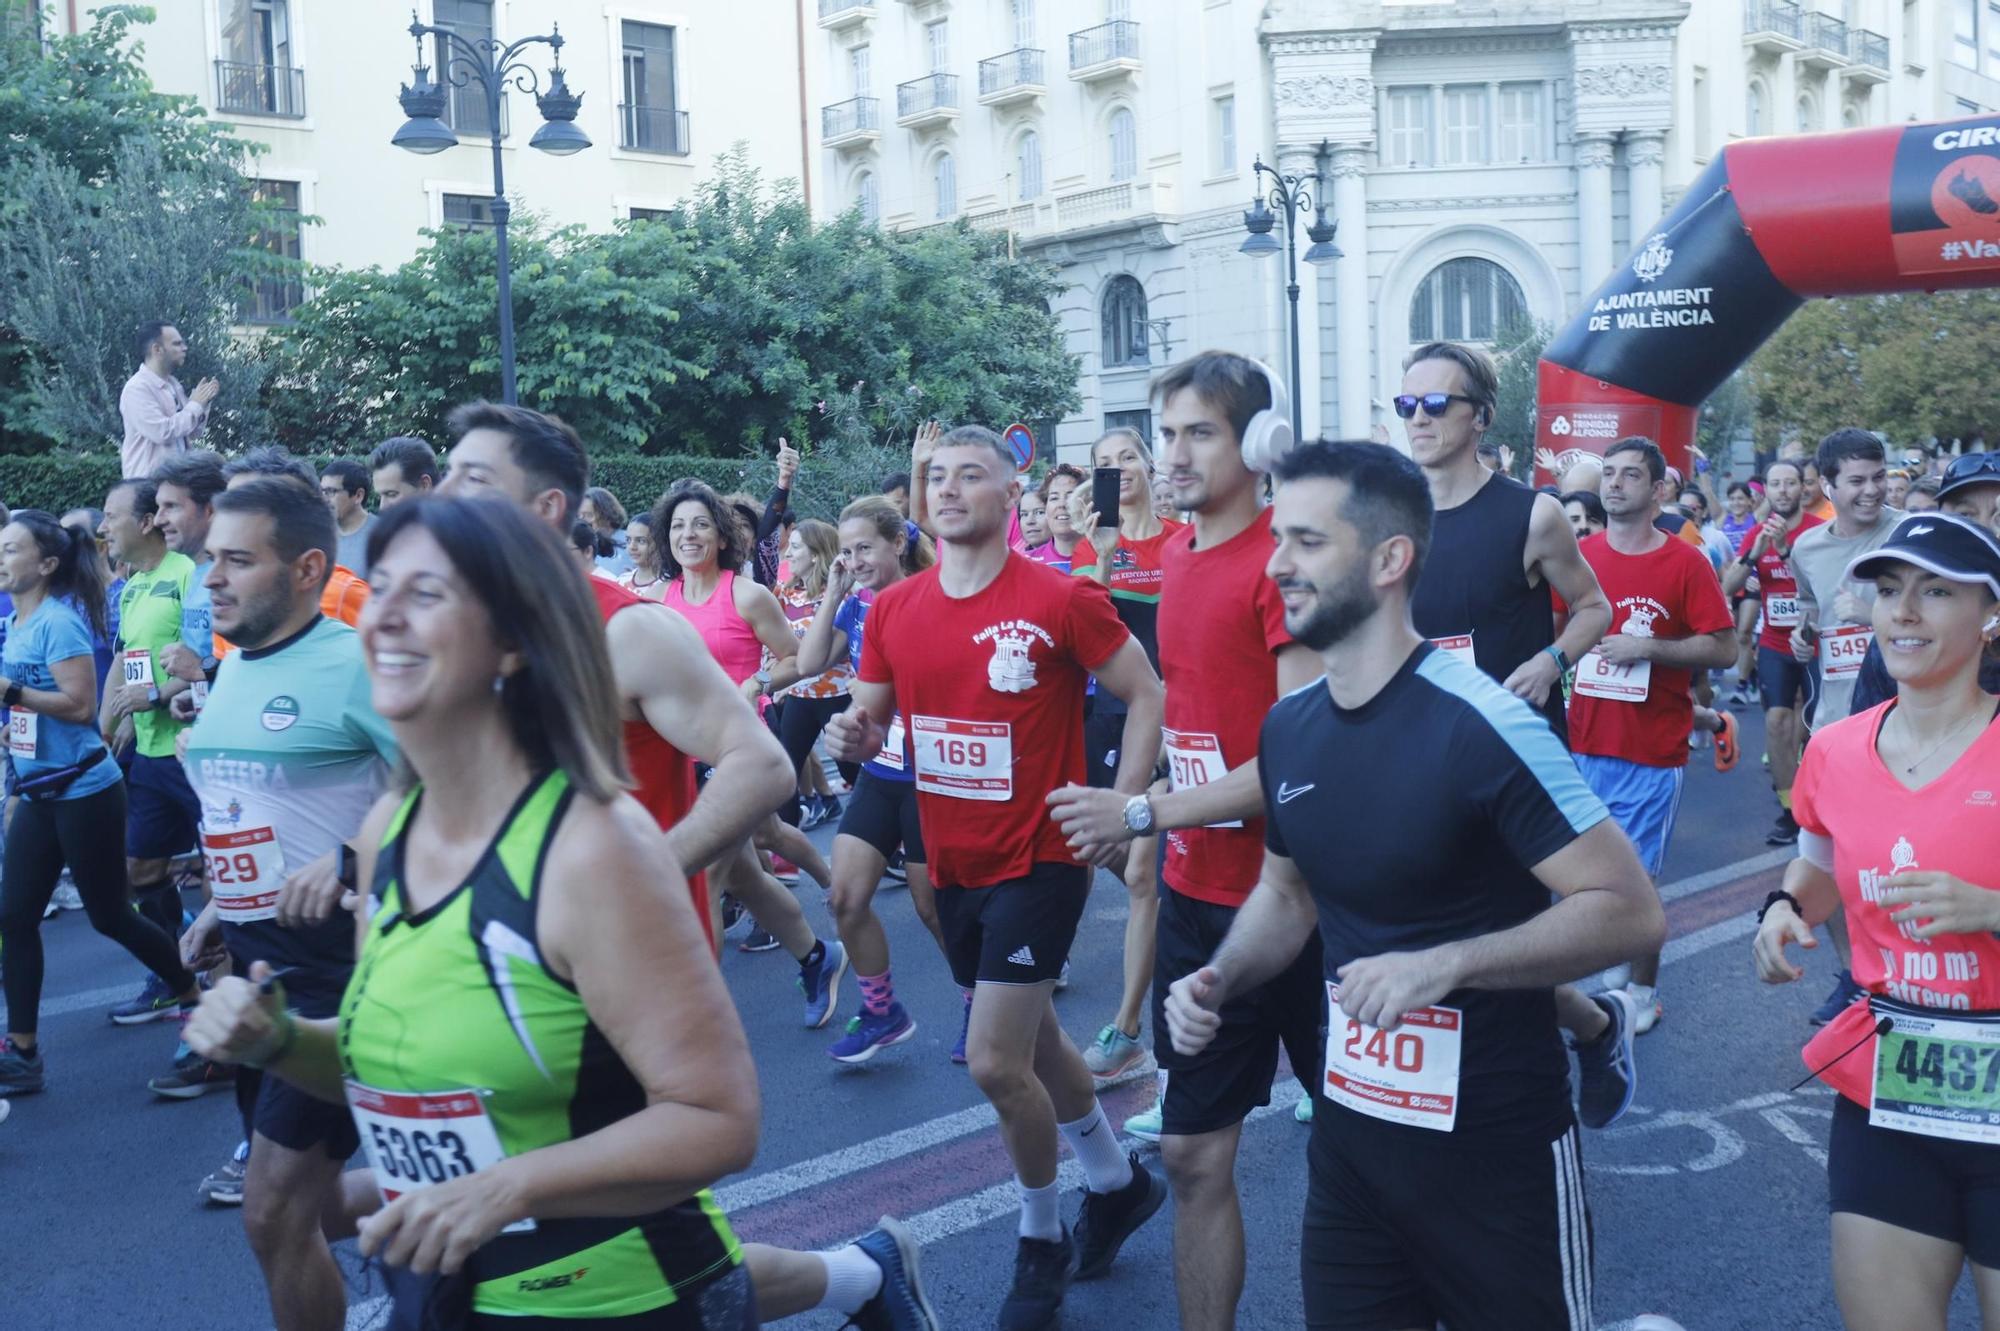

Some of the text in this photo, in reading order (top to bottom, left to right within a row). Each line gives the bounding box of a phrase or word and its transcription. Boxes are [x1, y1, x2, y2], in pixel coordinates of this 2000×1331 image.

[1593, 287, 1713, 313] AJUNTAMENT
[1588, 308, 1715, 331] DE VALÈNCIA
[1571, 429, 1618, 438] ALFONSO
[1572, 420, 1619, 429] TRINIDAD
[972, 619, 1055, 648] Falla La Barraca
[1829, 638, 1869, 657] 549
[934, 739, 986, 767] 169
[1904, 951, 1937, 980] no
[1944, 951, 1979, 981] me
[1345, 1019, 1424, 1074] 240
[1895, 1039, 2000, 1094] 4437
[369, 1122, 476, 1184] 5363
